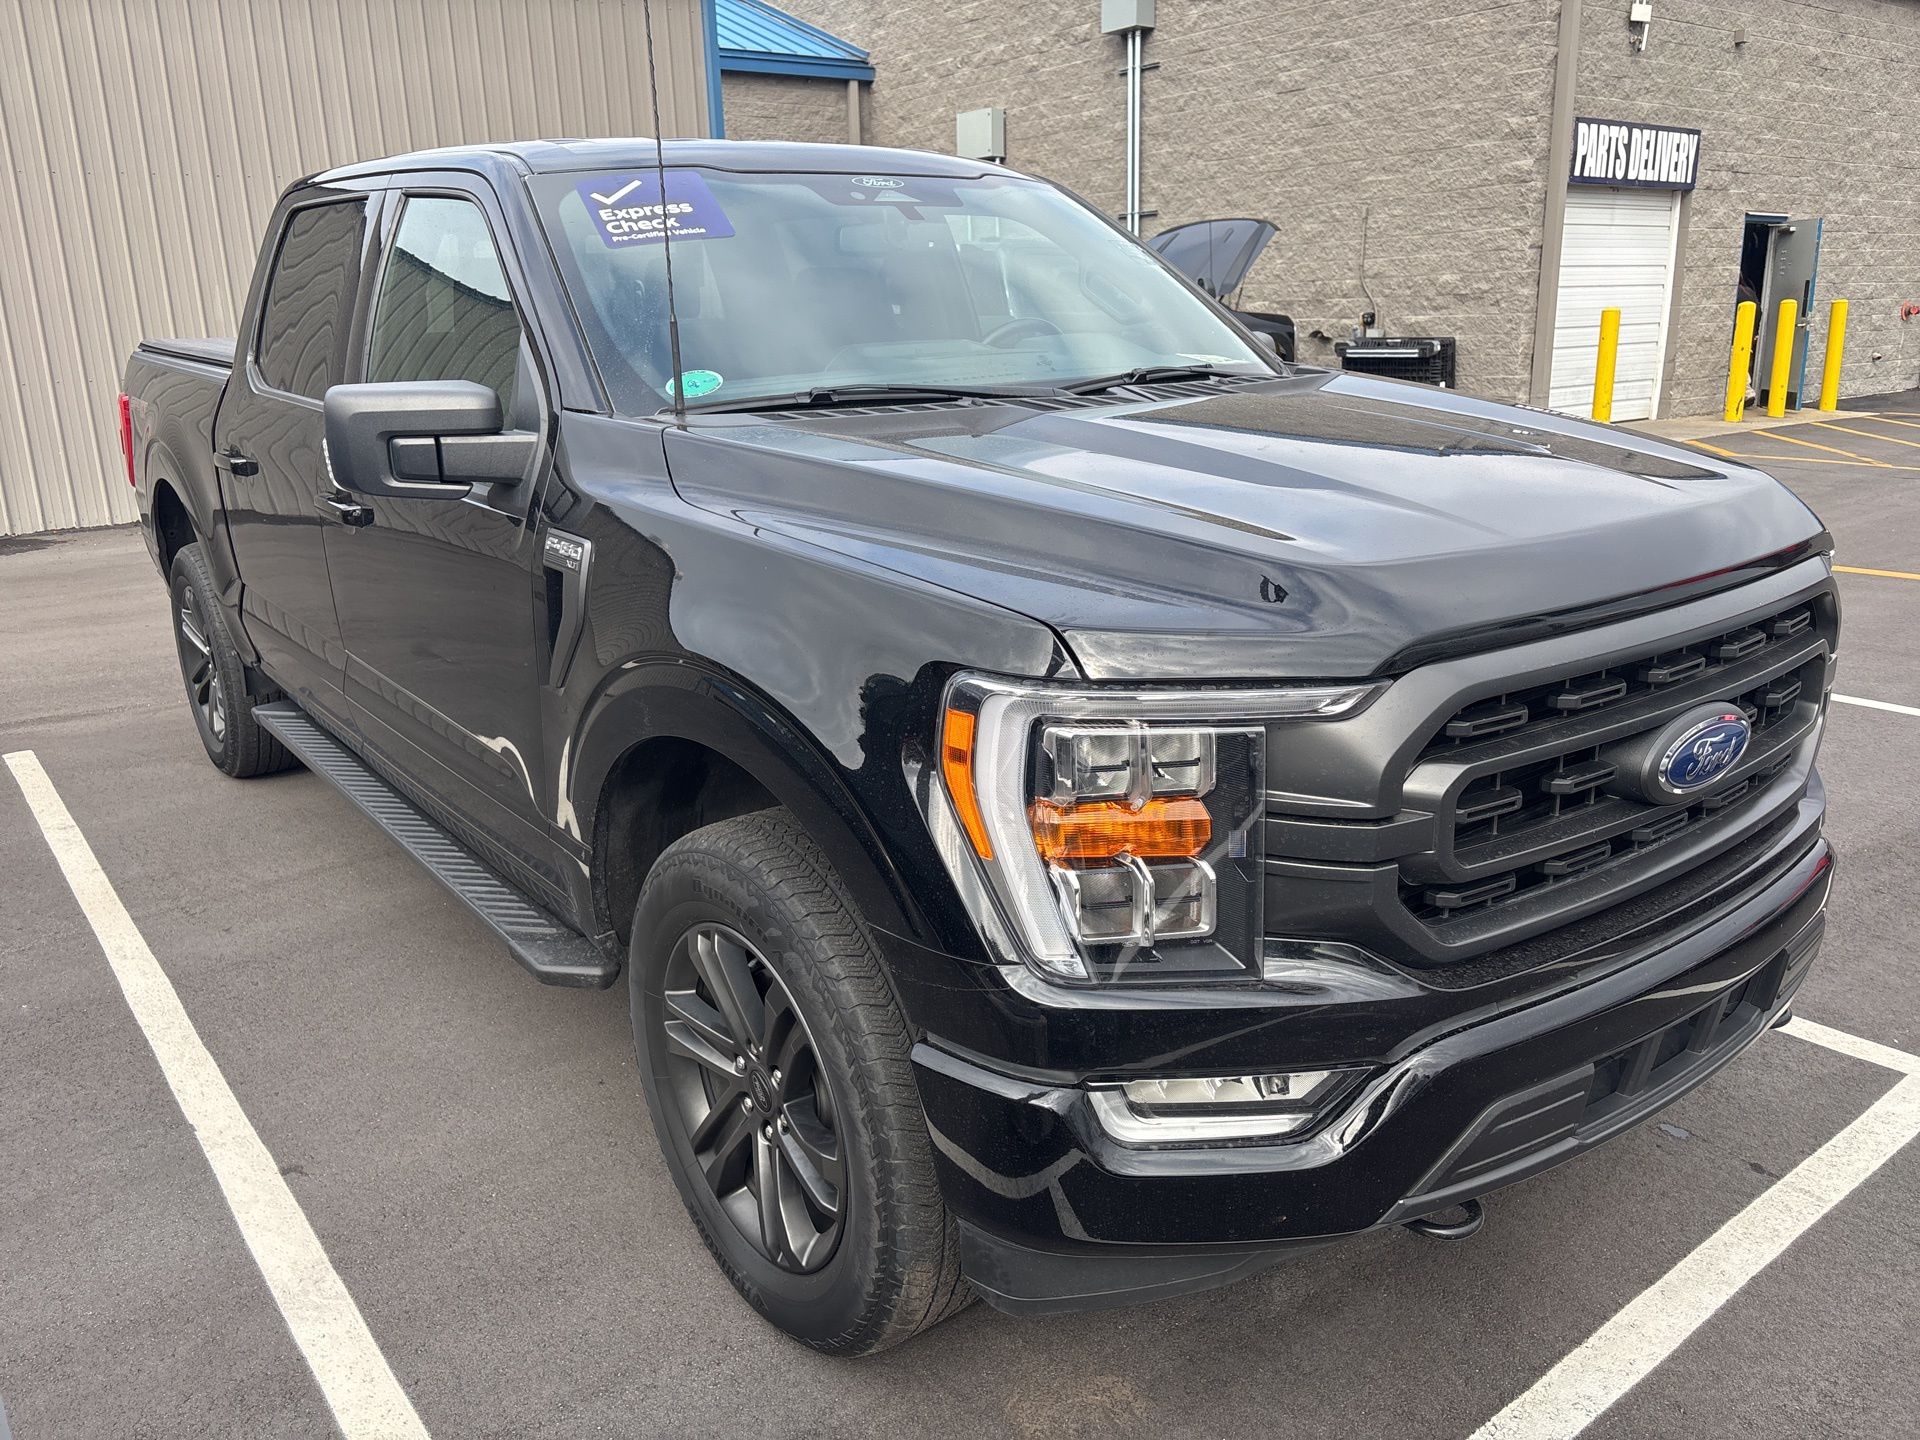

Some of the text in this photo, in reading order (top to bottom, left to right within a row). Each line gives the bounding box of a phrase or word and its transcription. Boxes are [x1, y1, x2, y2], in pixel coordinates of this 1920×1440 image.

[1573, 122, 1698, 184] PARTS DELIVERY
[598, 203, 693, 221] Express
[606, 215, 680, 233] Check
[672, 227, 706, 235] Vehicle
[1685, 732, 1737, 781] Ford
